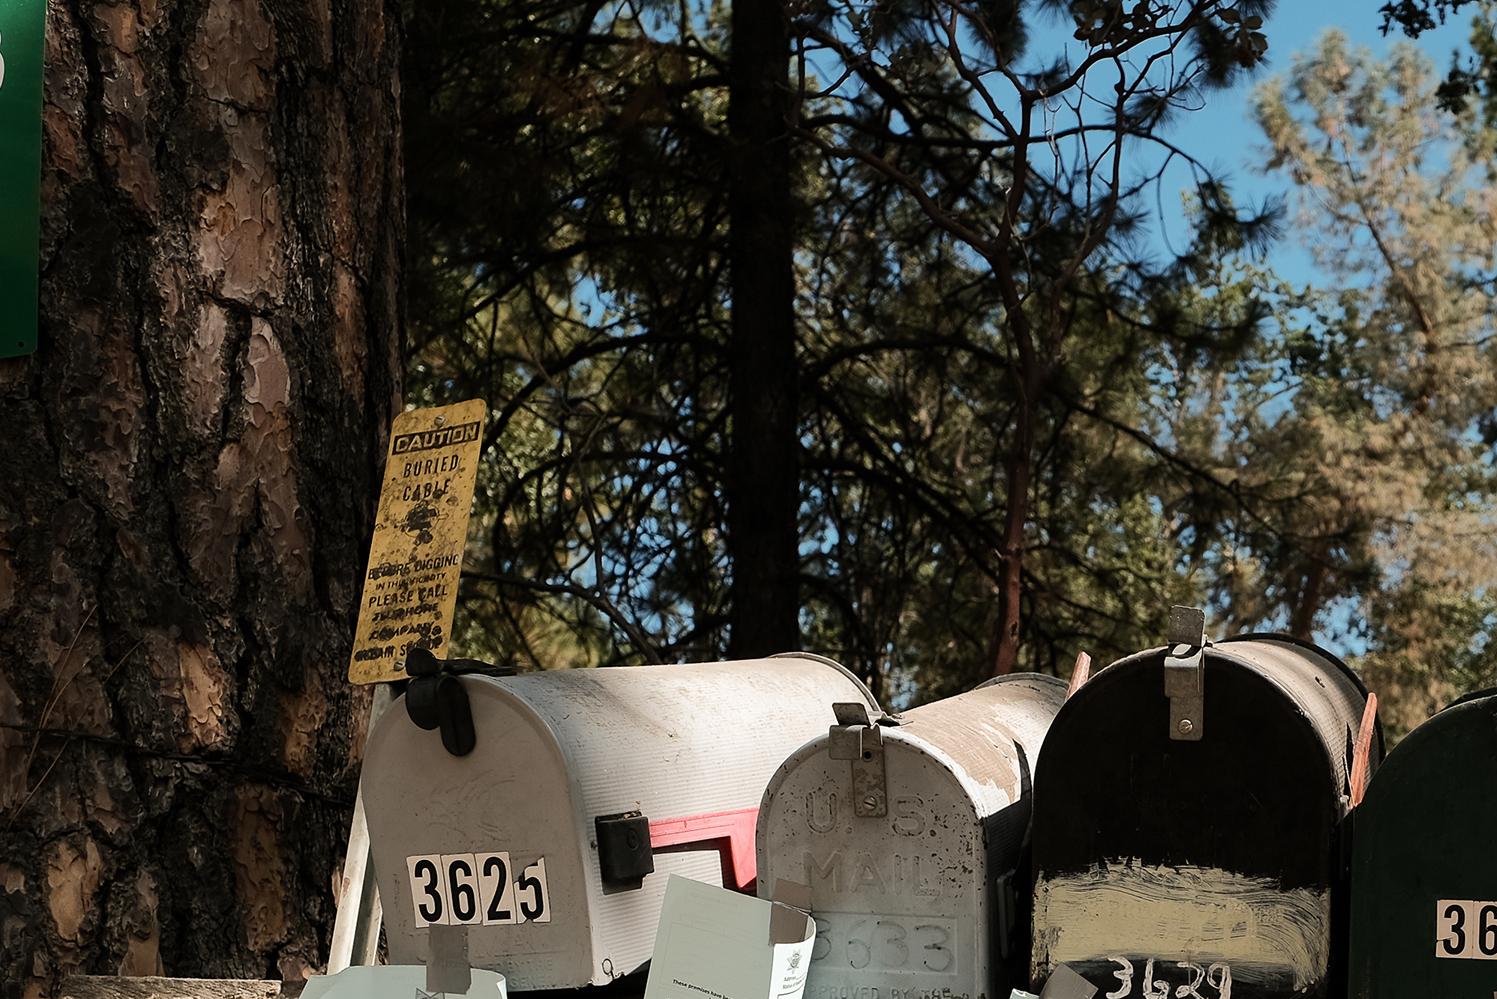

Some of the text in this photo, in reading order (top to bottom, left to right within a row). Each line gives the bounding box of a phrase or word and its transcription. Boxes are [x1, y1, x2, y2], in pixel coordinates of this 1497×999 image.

[396, 424, 477, 452] CAUTION
[404, 454, 458, 478] BURIED
[402, 478, 450, 501] CABLE
[368, 562, 410, 580] BRE
[369, 584, 448, 608] PLEASE CALL
[388, 580, 408, 591] THI
[803, 849, 941, 897] MAIL
[414, 856, 544, 922] 3625
[673, 979, 687, 987] These
[688, 983, 709, 994] premises
